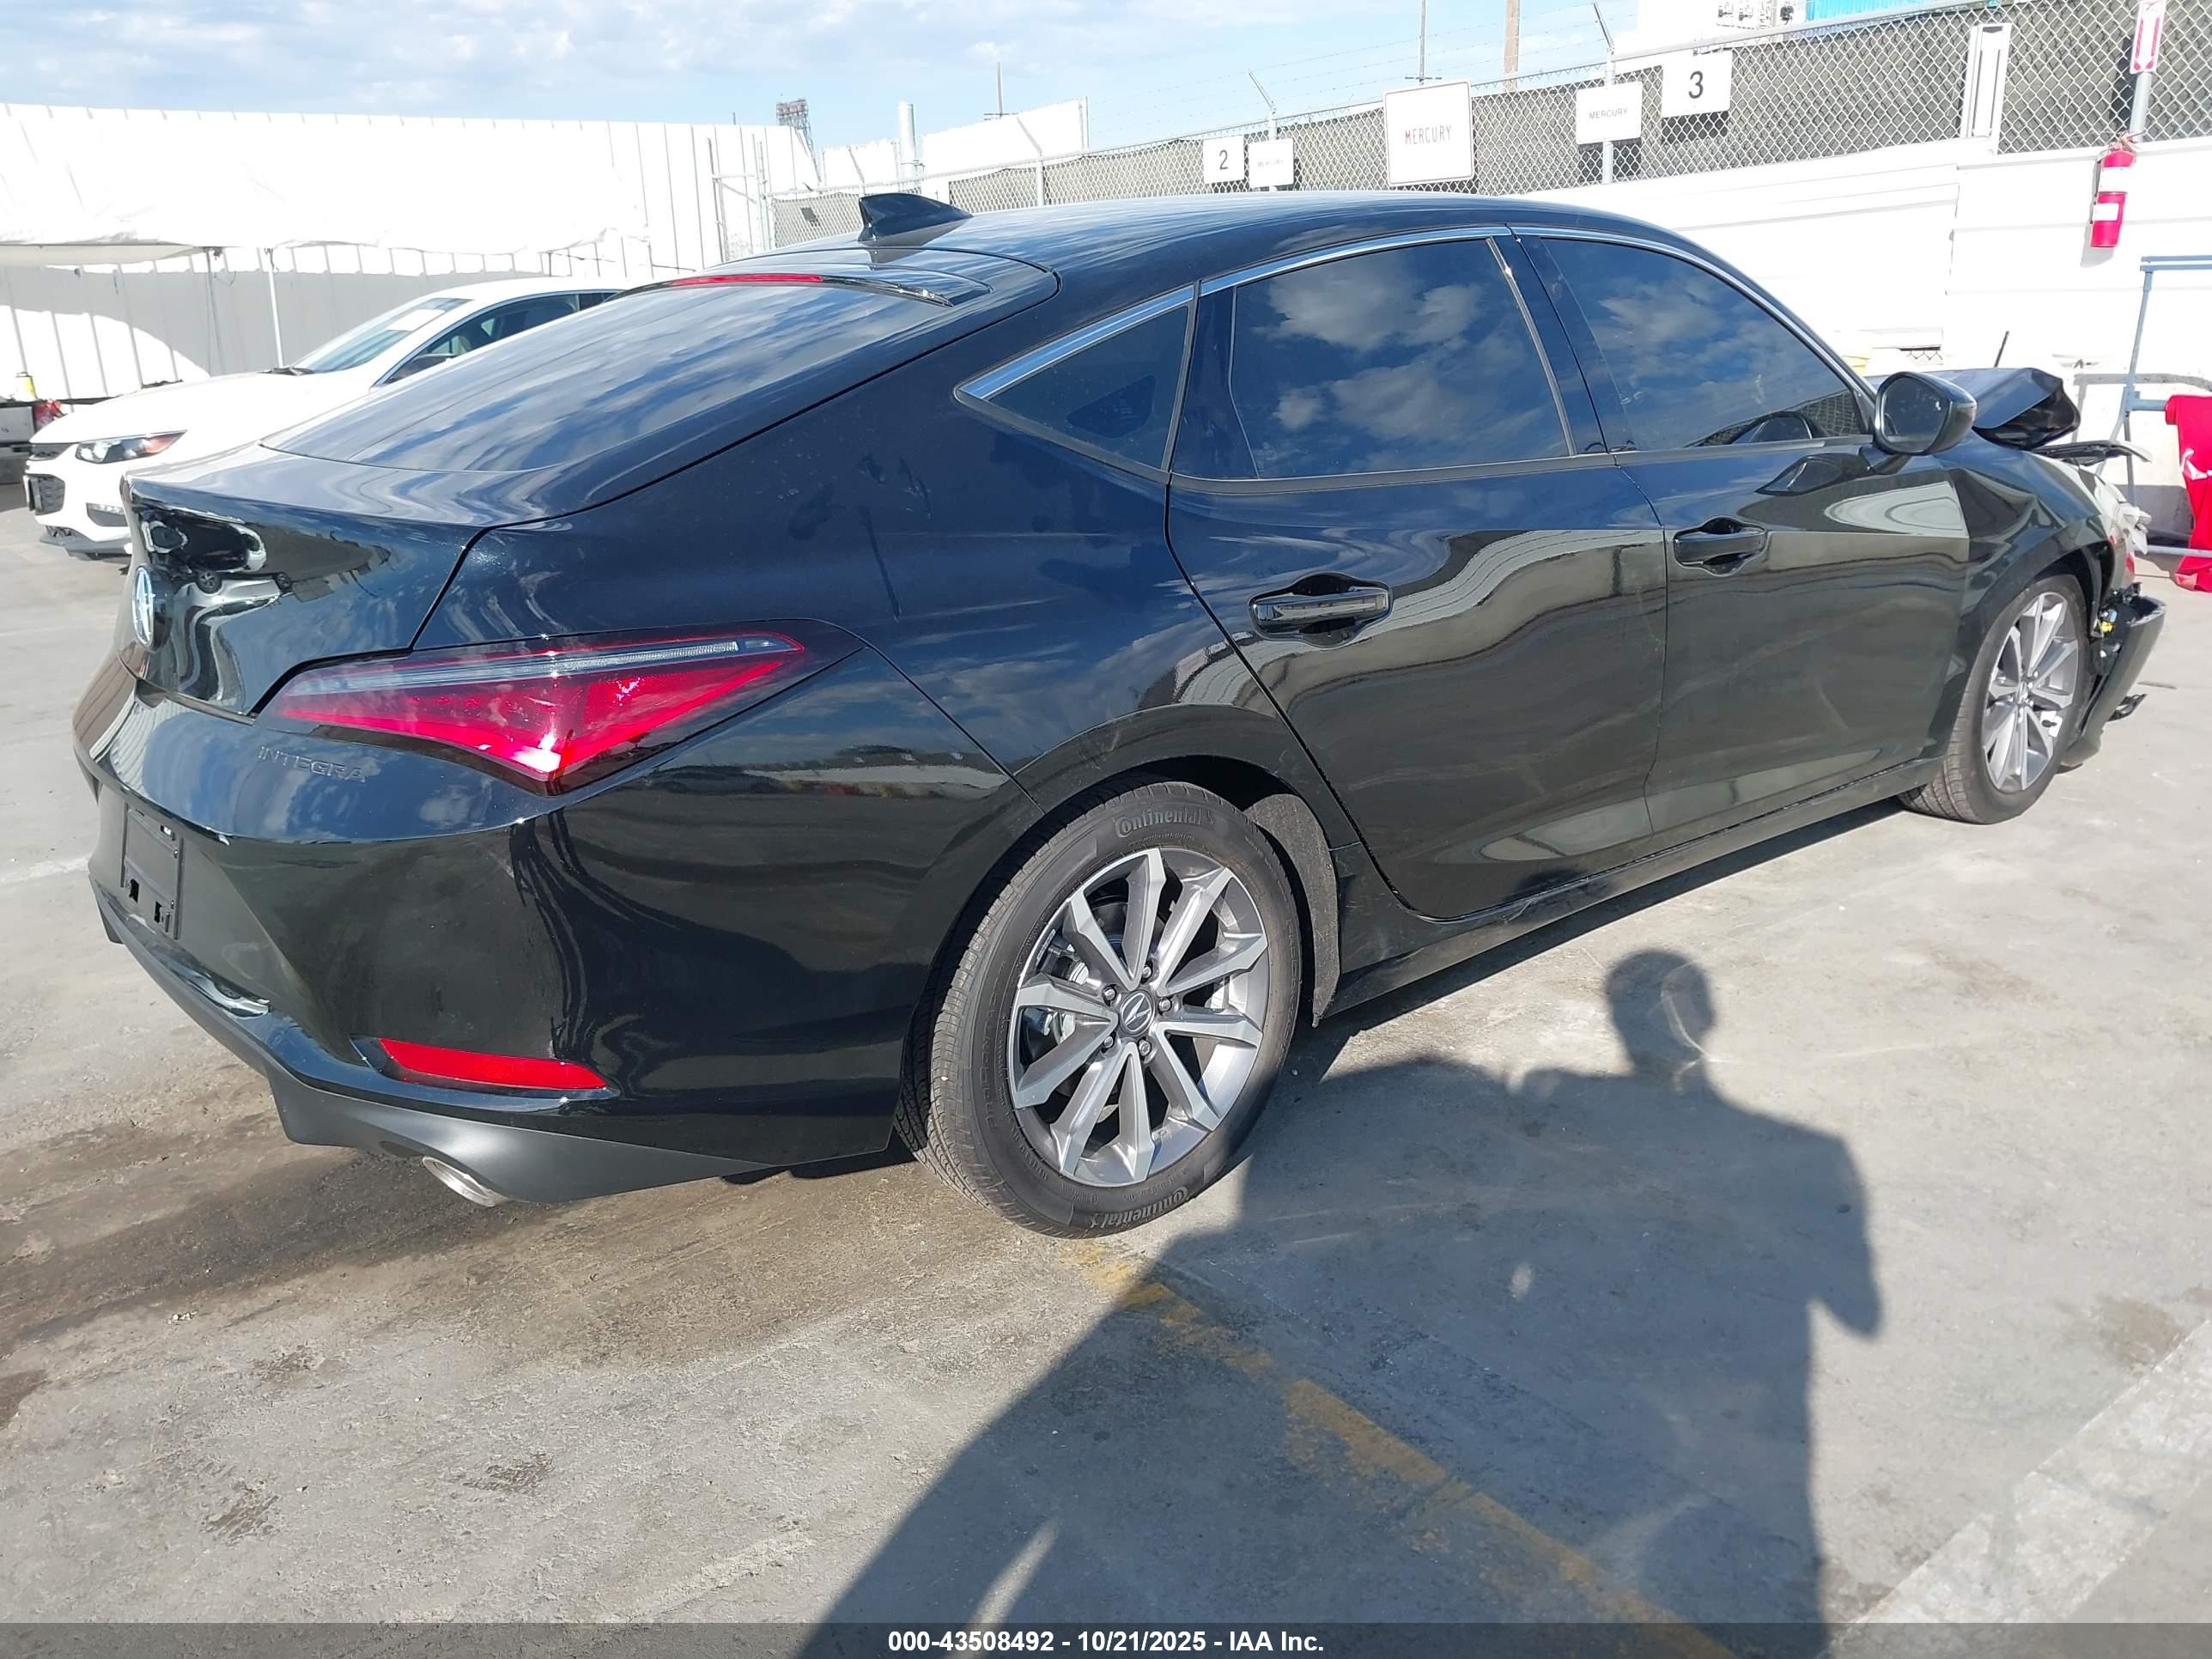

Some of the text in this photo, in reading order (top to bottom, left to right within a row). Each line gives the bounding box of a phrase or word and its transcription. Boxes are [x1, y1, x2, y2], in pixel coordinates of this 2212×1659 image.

[1688, 70, 1704, 99] 3
[1589, 107, 1628, 119] MERCURY
[1405, 125, 1451, 145] MERCURY
[1219, 149, 1229, 170] 2
[258, 745, 367, 783] INTEGRA
[1115, 807, 1201, 838] Continental
[1100, 1186, 1188, 1229] Continental
